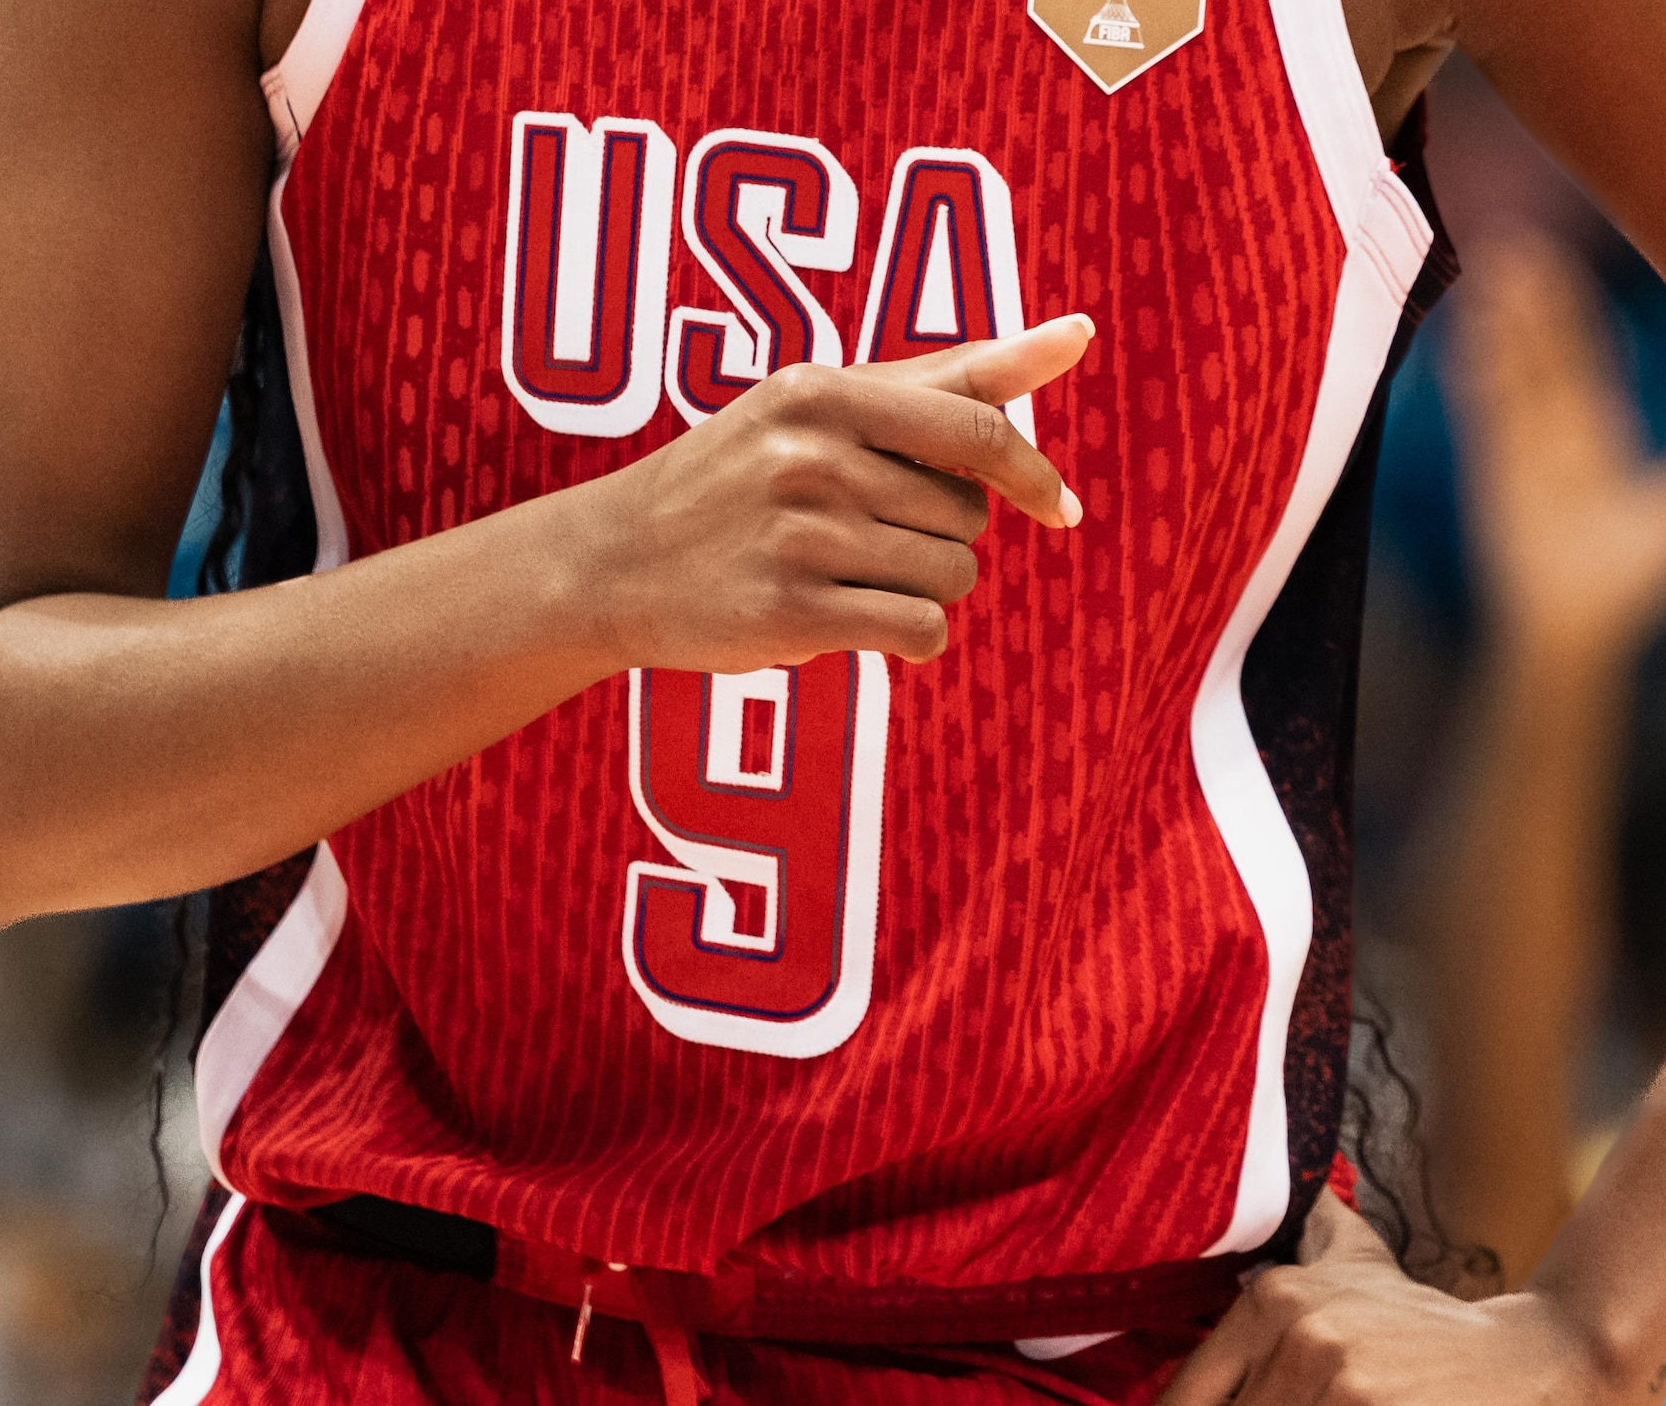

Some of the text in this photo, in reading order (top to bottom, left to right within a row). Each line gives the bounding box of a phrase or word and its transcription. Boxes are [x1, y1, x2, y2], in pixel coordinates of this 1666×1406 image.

[1098, 24, 1131, 42] FIBA
[501, 110, 1037, 454] USA
[622, 650, 890, 1059] 9
